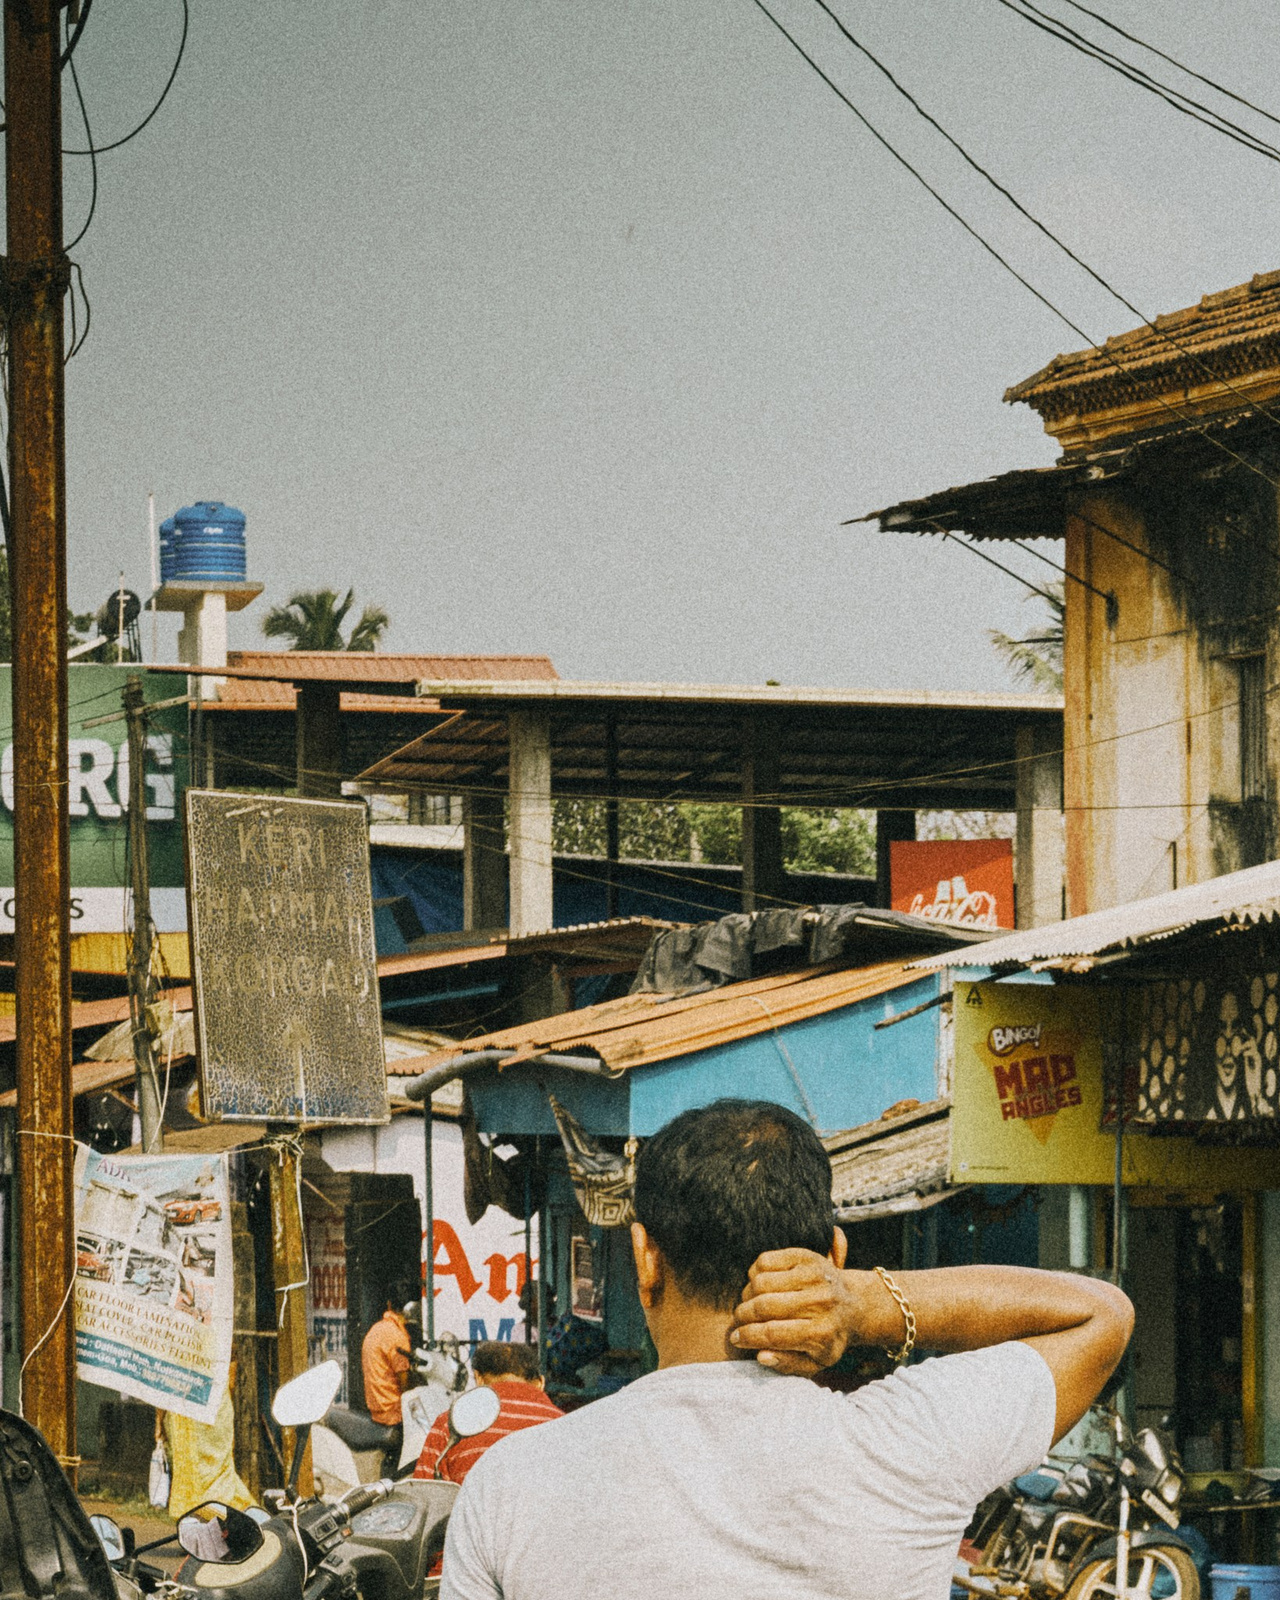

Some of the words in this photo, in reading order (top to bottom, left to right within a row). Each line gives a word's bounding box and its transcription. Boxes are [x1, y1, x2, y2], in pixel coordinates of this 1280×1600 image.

[1, 733, 175, 820] RG
[238, 823, 327, 869] KERI
[991, 1024, 1041, 1052] BINGO!
[993, 1054, 1077, 1100] MAD
[1001, 1086, 1083, 1121] ANGLES
[77, 1287, 97, 1300] CAR
[98, 1293, 134, 1313] FLOOR
[77, 1315, 97, 1328] CAR
